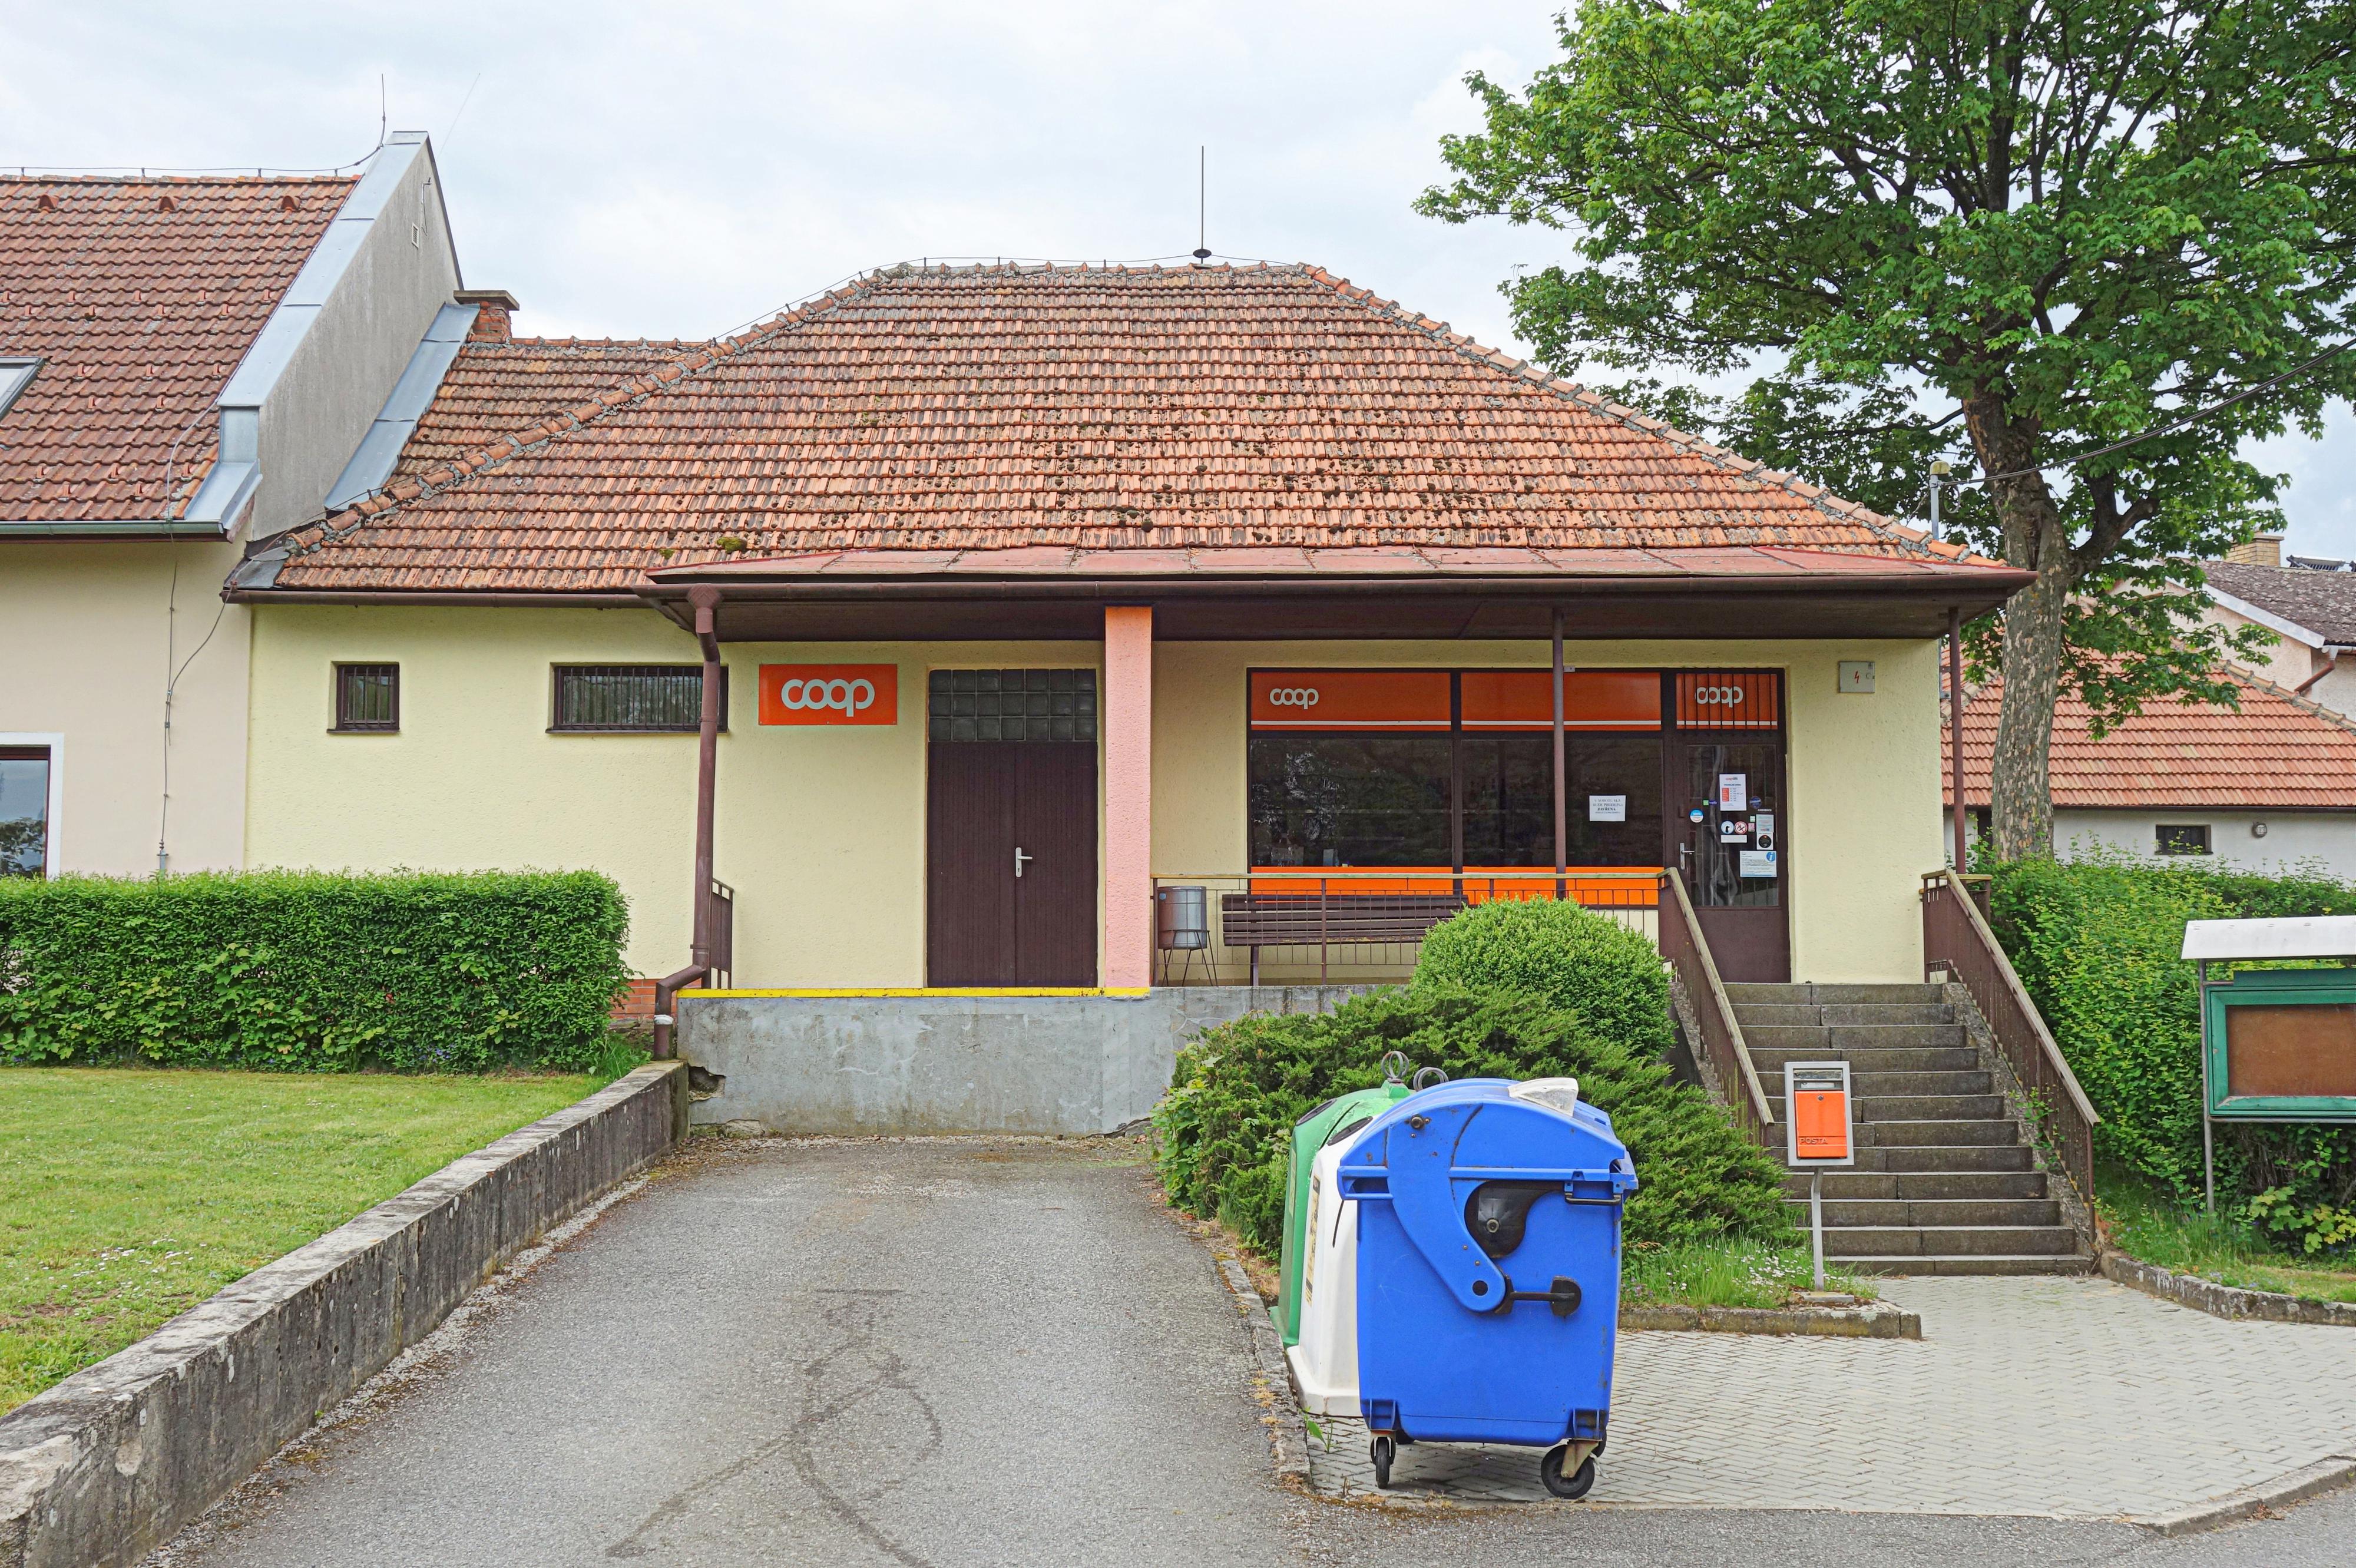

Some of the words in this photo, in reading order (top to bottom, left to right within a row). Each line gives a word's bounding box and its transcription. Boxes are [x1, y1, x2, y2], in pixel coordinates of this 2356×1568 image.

[781, 679, 875, 717] coop
[1269, 688, 1319, 710] coop
[1695, 686, 1743, 708] coop
[1799, 1137, 1828, 1145] POSTA
